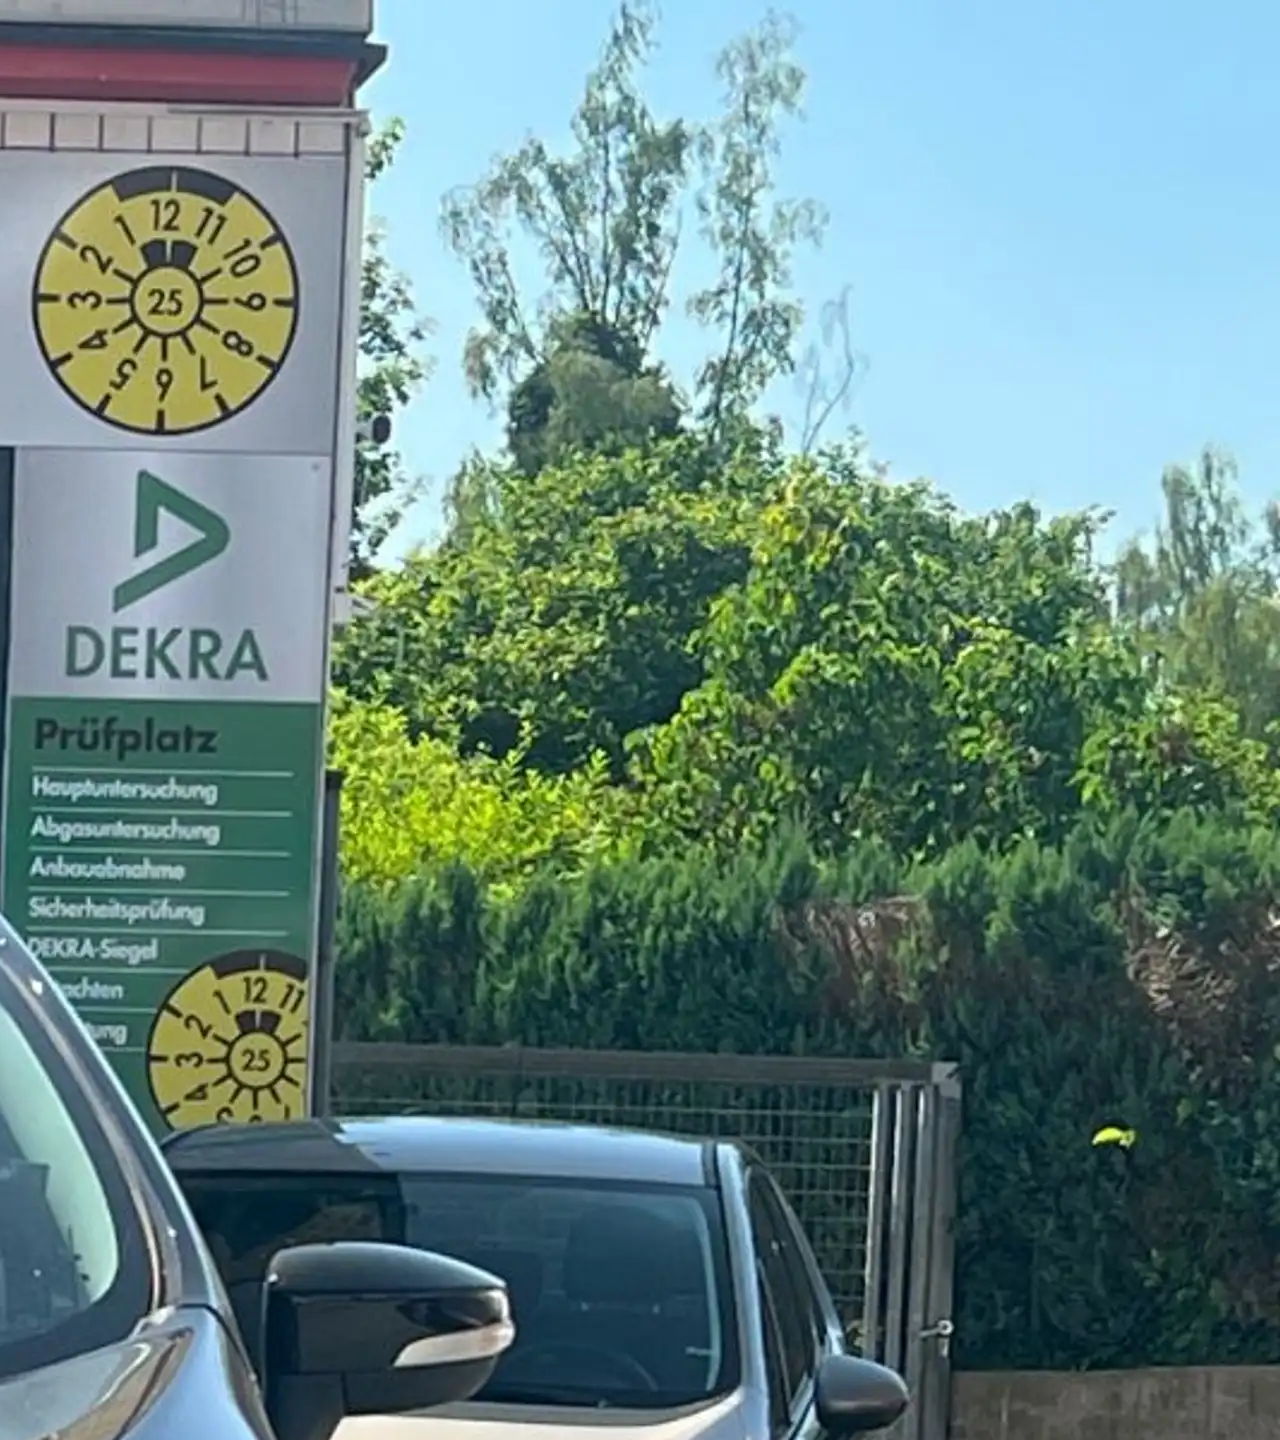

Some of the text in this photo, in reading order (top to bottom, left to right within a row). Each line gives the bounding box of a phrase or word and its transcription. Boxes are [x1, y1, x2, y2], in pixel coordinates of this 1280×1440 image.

[150, 199, 181, 231] 12
[194, 207, 228, 245] 11
[113, 215, 136, 246] 1
[79, 245, 114, 275] 2
[223, 238, 262, 279] 10
[67, 290, 103, 310] 3
[147, 289, 183, 317] 25
[234, 292, 267, 312] 9
[78, 329, 108, 350] 4
[222, 330, 254, 357] 8
[109, 359, 138, 390] 5
[156, 368, 173, 402] 6
[201, 356, 218, 392] 7
[65, 625, 269, 682] DEKRA
[34, 717, 219, 762] Prüfplatz
[32, 775, 219, 806] Hauptuntersuchung
[30, 815, 221, 846] Abgasuntersuchung
[30, 855, 185, 880] Anbauabnahme
[28, 896, 205, 926] Sicherheitsprüfung
[28, 936, 159, 966] DEKRA-Siegel
[59, 976, 124, 999] achten
[213, 989, 231, 1015] 1
[243, 976, 267, 1003] 12
[280, 984, 304, 1013] 11
[184, 1015, 213, 1040] 2
[174, 1052, 203, 1068] 3
[241, 1049, 271, 1072] 25
[183, 1083, 208, 1101] 4
